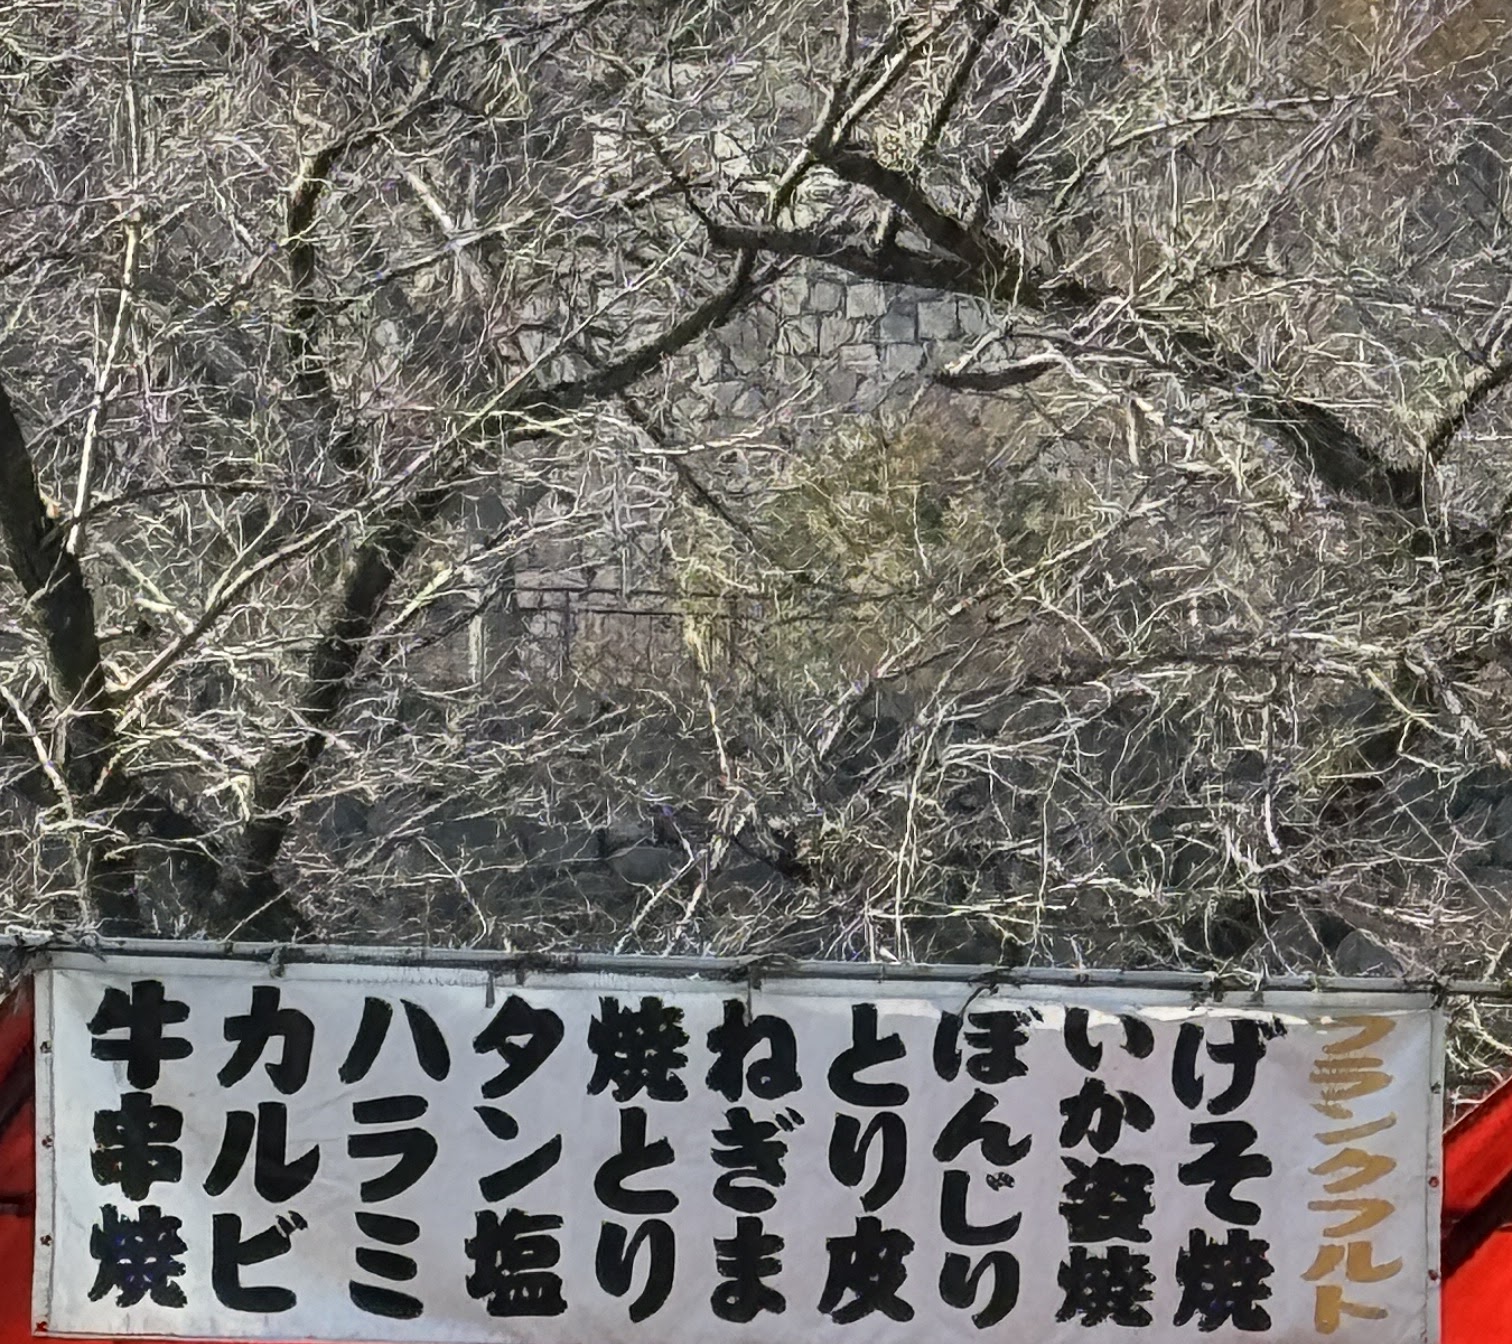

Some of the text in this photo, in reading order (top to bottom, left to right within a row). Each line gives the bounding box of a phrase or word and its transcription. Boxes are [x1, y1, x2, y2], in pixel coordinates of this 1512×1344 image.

[88, 979, 194, 1308] 牛串焼
[203, 985, 321, 1312] カルビ
[339, 996, 452, 1320] ハラミ
[464, 994, 569, 1318] タン塩
[586, 996, 690, 1324] 焼とり
[706, 999, 805, 1324] ねぎま
[817, 1002, 915, 1325] とり皮
[932, 1004, 1046, 1329] ぼんじり
[1055, 1006, 1157, 1327] いか姿焼
[1172, 1013, 1289, 1332] げそ焼
[1301, 1013, 1404, 1335] フランクフルト
